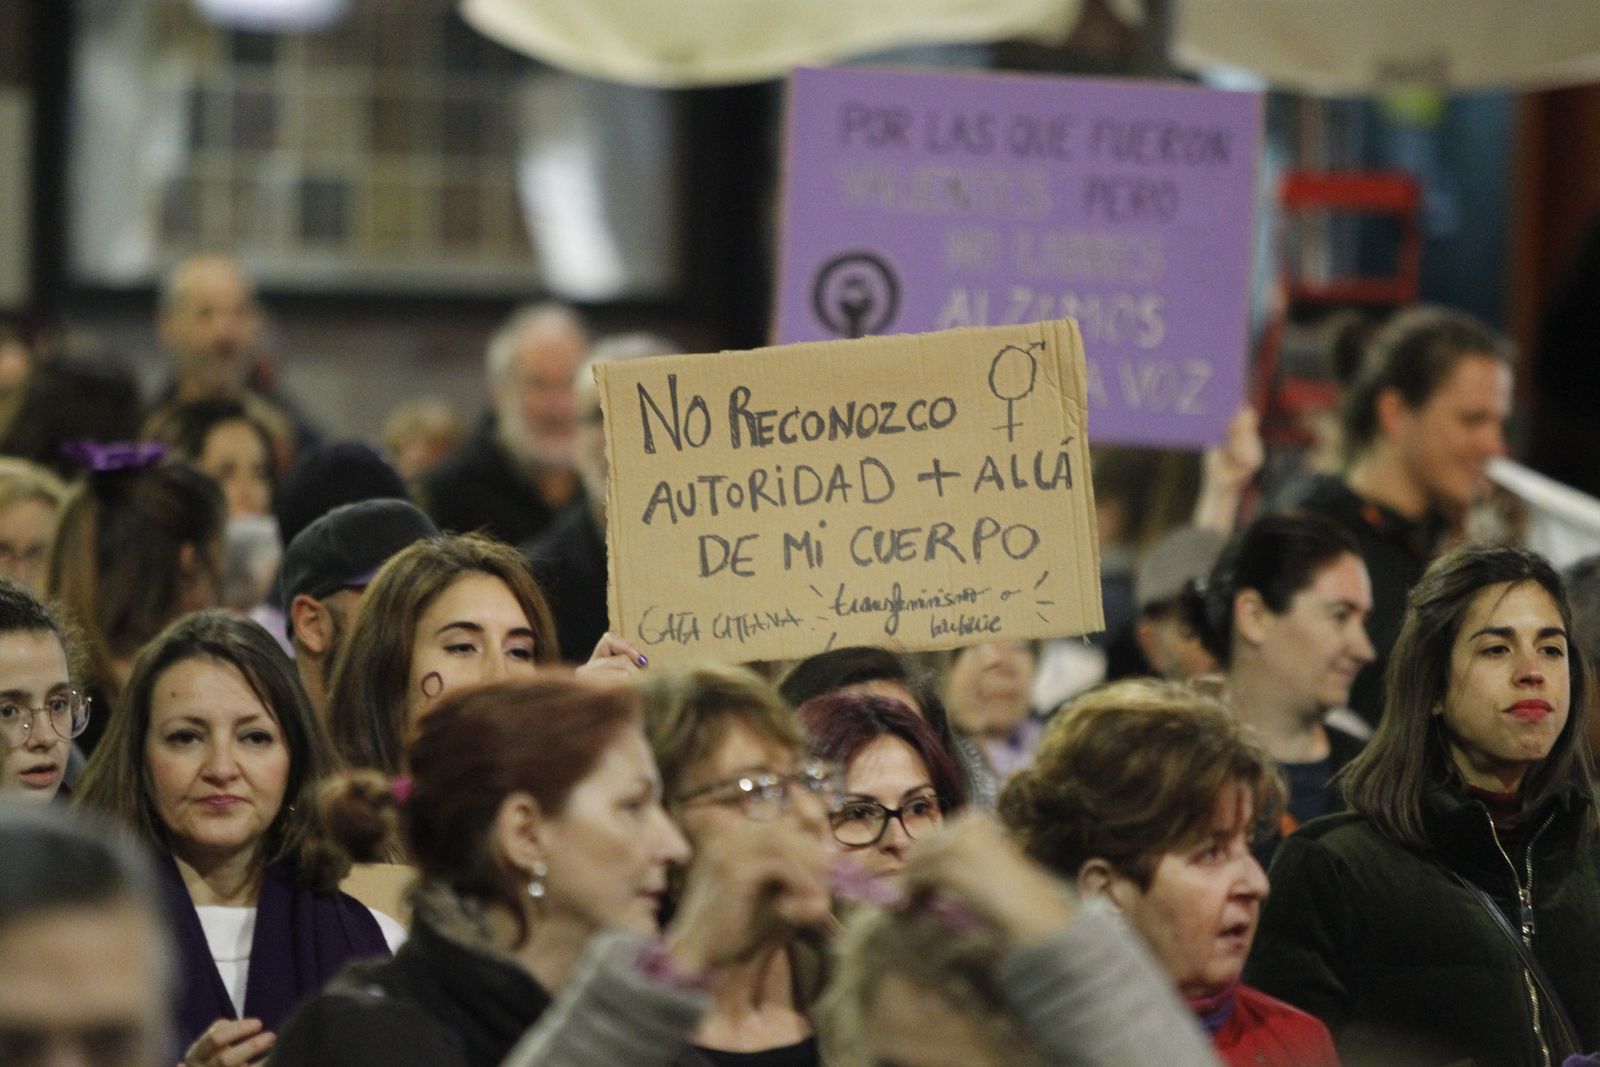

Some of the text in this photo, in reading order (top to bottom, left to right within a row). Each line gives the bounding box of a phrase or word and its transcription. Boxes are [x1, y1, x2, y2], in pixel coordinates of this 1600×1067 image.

[925, 111, 996, 157] LAS
[1007, 115, 1074, 162] QUE
[1090, 119, 1233, 166] FUERON
[1081, 175, 1181, 223] PERO
[637, 374, 957, 454] NO RECONOZCO
[1118, 359, 1213, 415] VOZ
[973, 436, 1075, 493] ALLÁ
[697, 533, 761, 578] DE
[849, 516, 1041, 566] CUERPO
